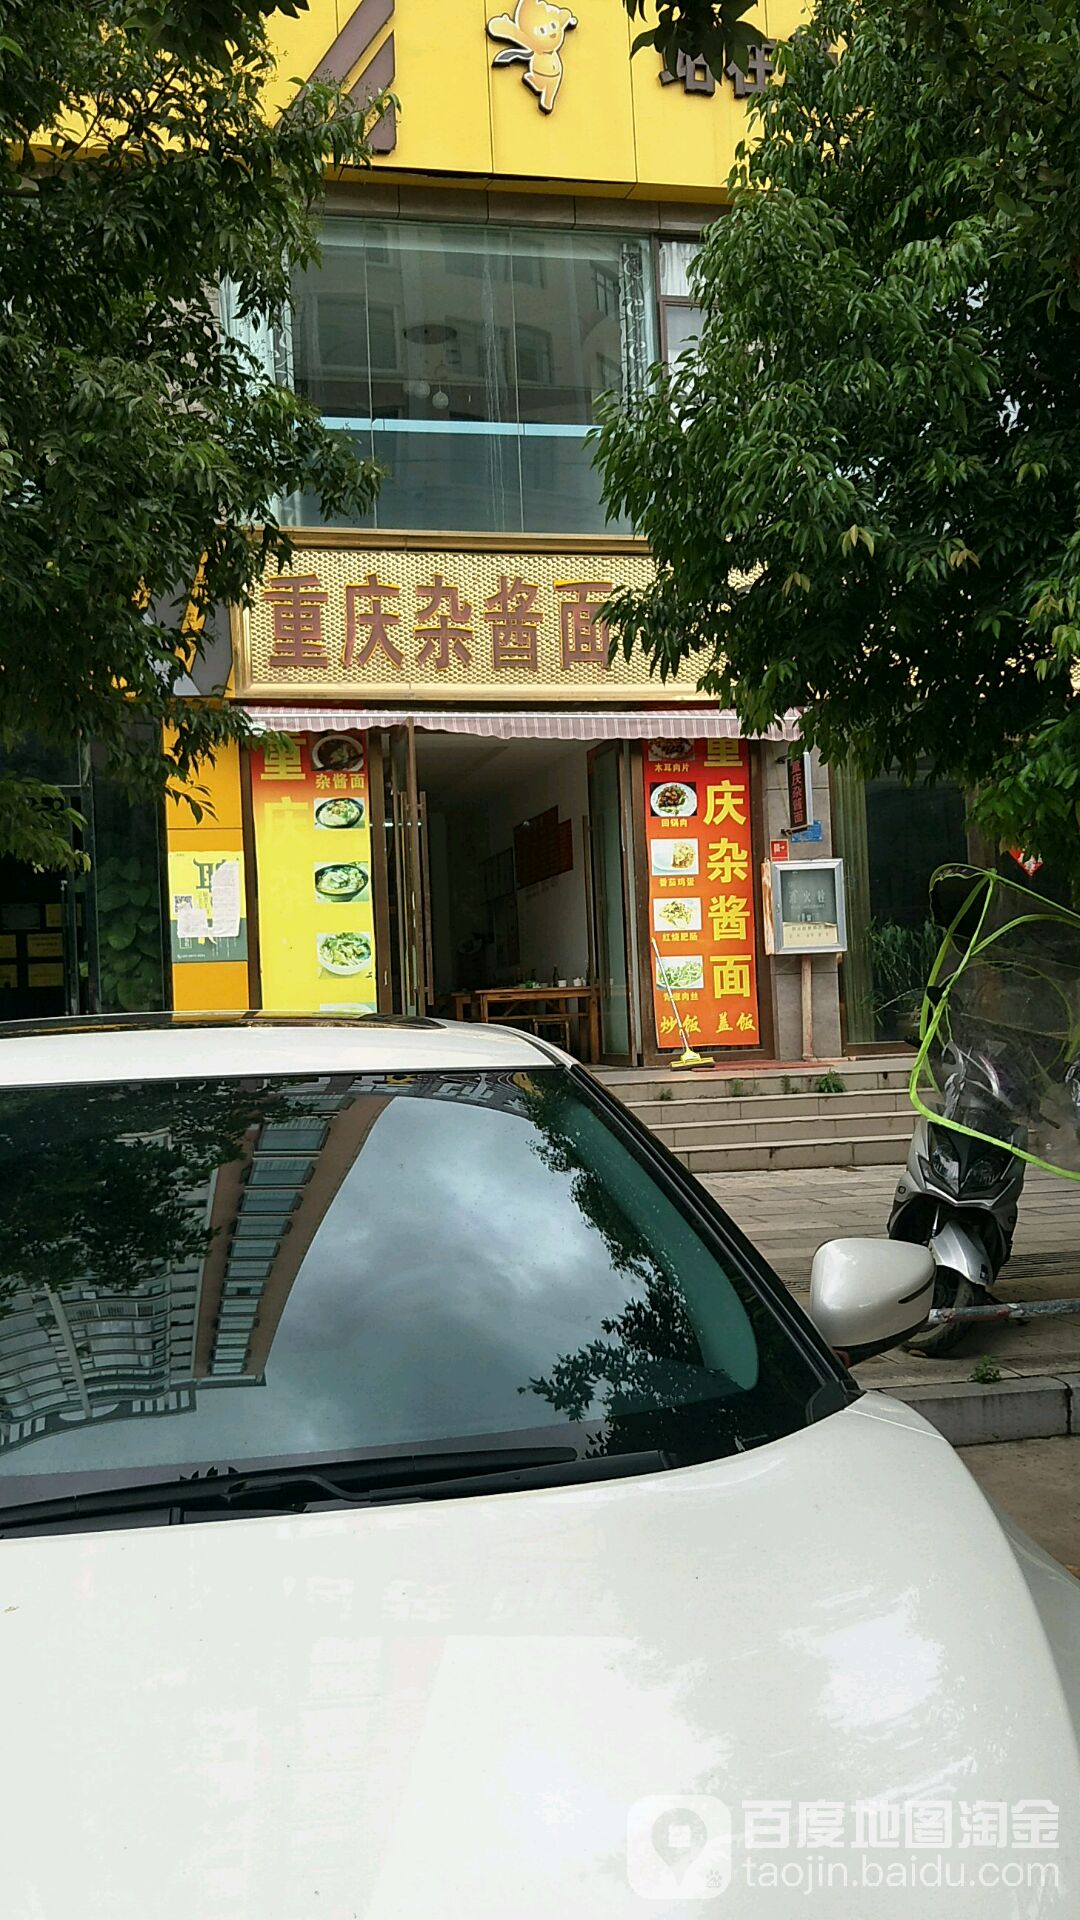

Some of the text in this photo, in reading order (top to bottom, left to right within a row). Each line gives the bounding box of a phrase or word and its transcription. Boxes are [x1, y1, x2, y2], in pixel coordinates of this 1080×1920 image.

[263, 572, 614, 672] 重庆杂酱面
[654, 762, 690, 773] 木耳肉片
[315, 773, 366, 790] 杂酱面
[660, 817, 689, 828] 回锅肉
[660, 1011, 757, 1037] 炒饭 盖饭
